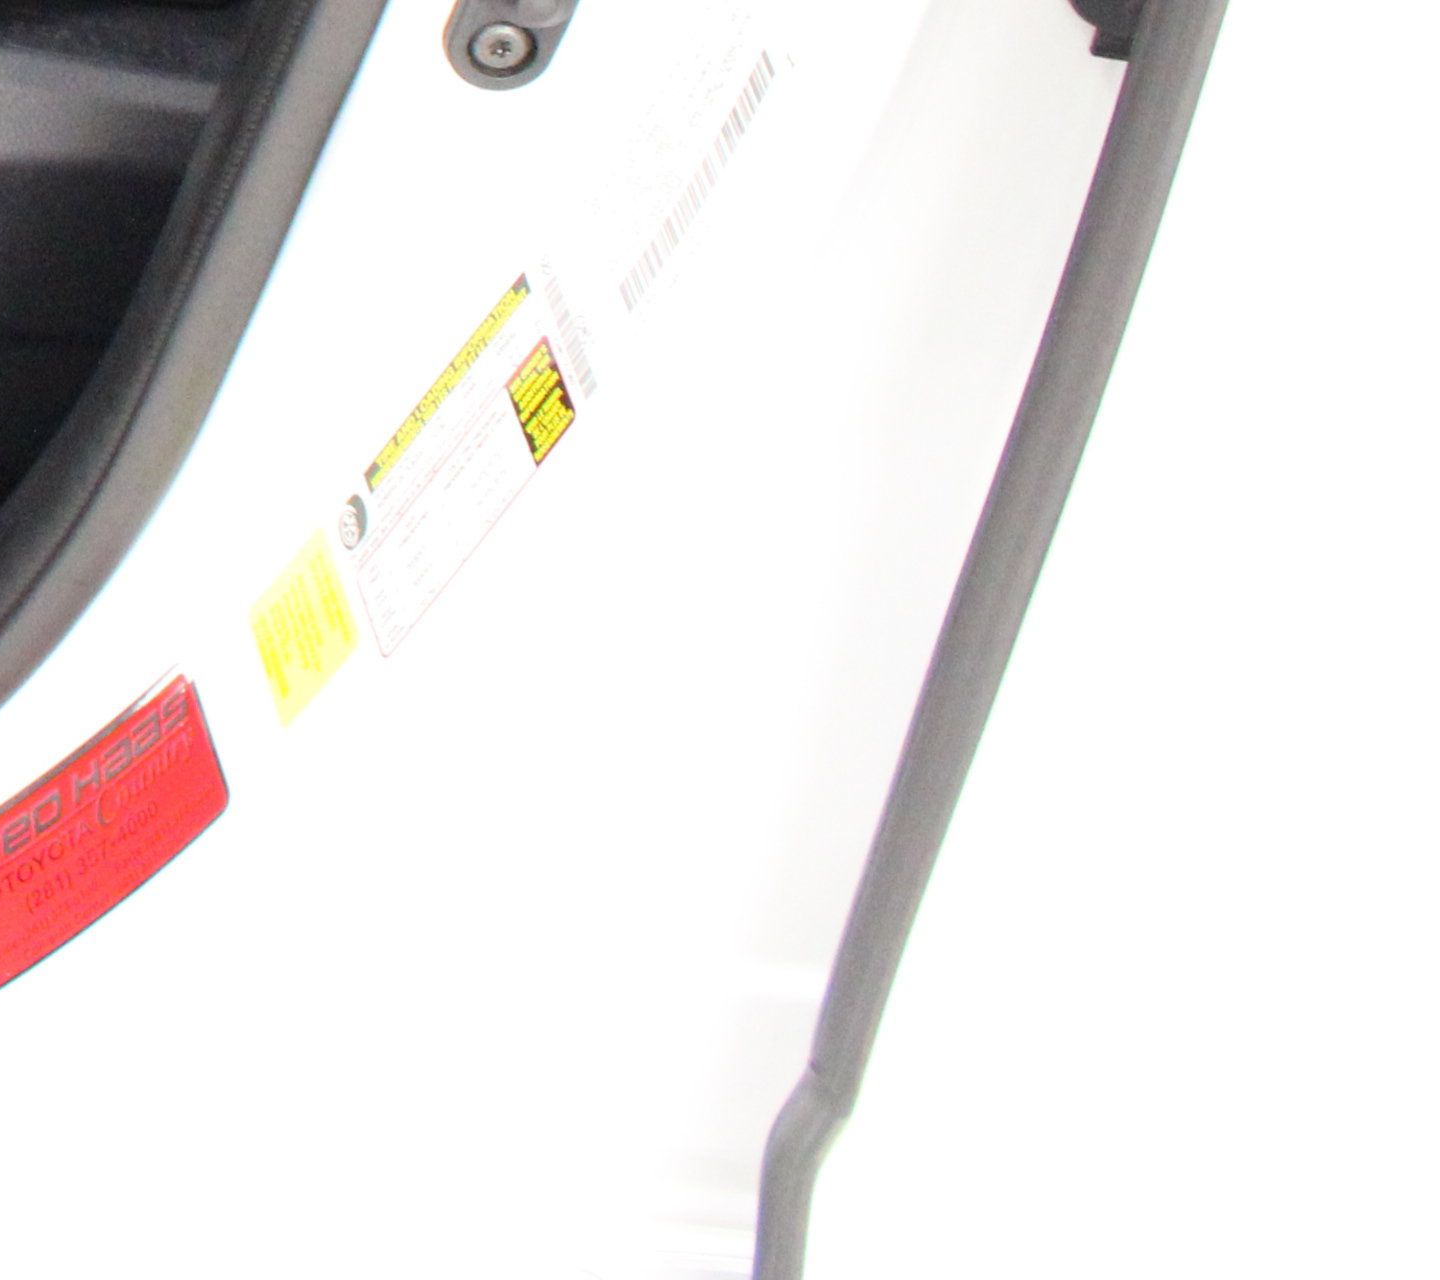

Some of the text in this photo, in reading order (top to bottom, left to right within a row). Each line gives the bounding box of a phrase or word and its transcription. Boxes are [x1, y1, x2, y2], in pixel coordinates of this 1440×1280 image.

[3, 823, 94, 893] TOYOTA
[96, 727, 193, 826] Country
[25, 871, 72, 914] (281)
[78, 800, 159, 875] 357-4000
